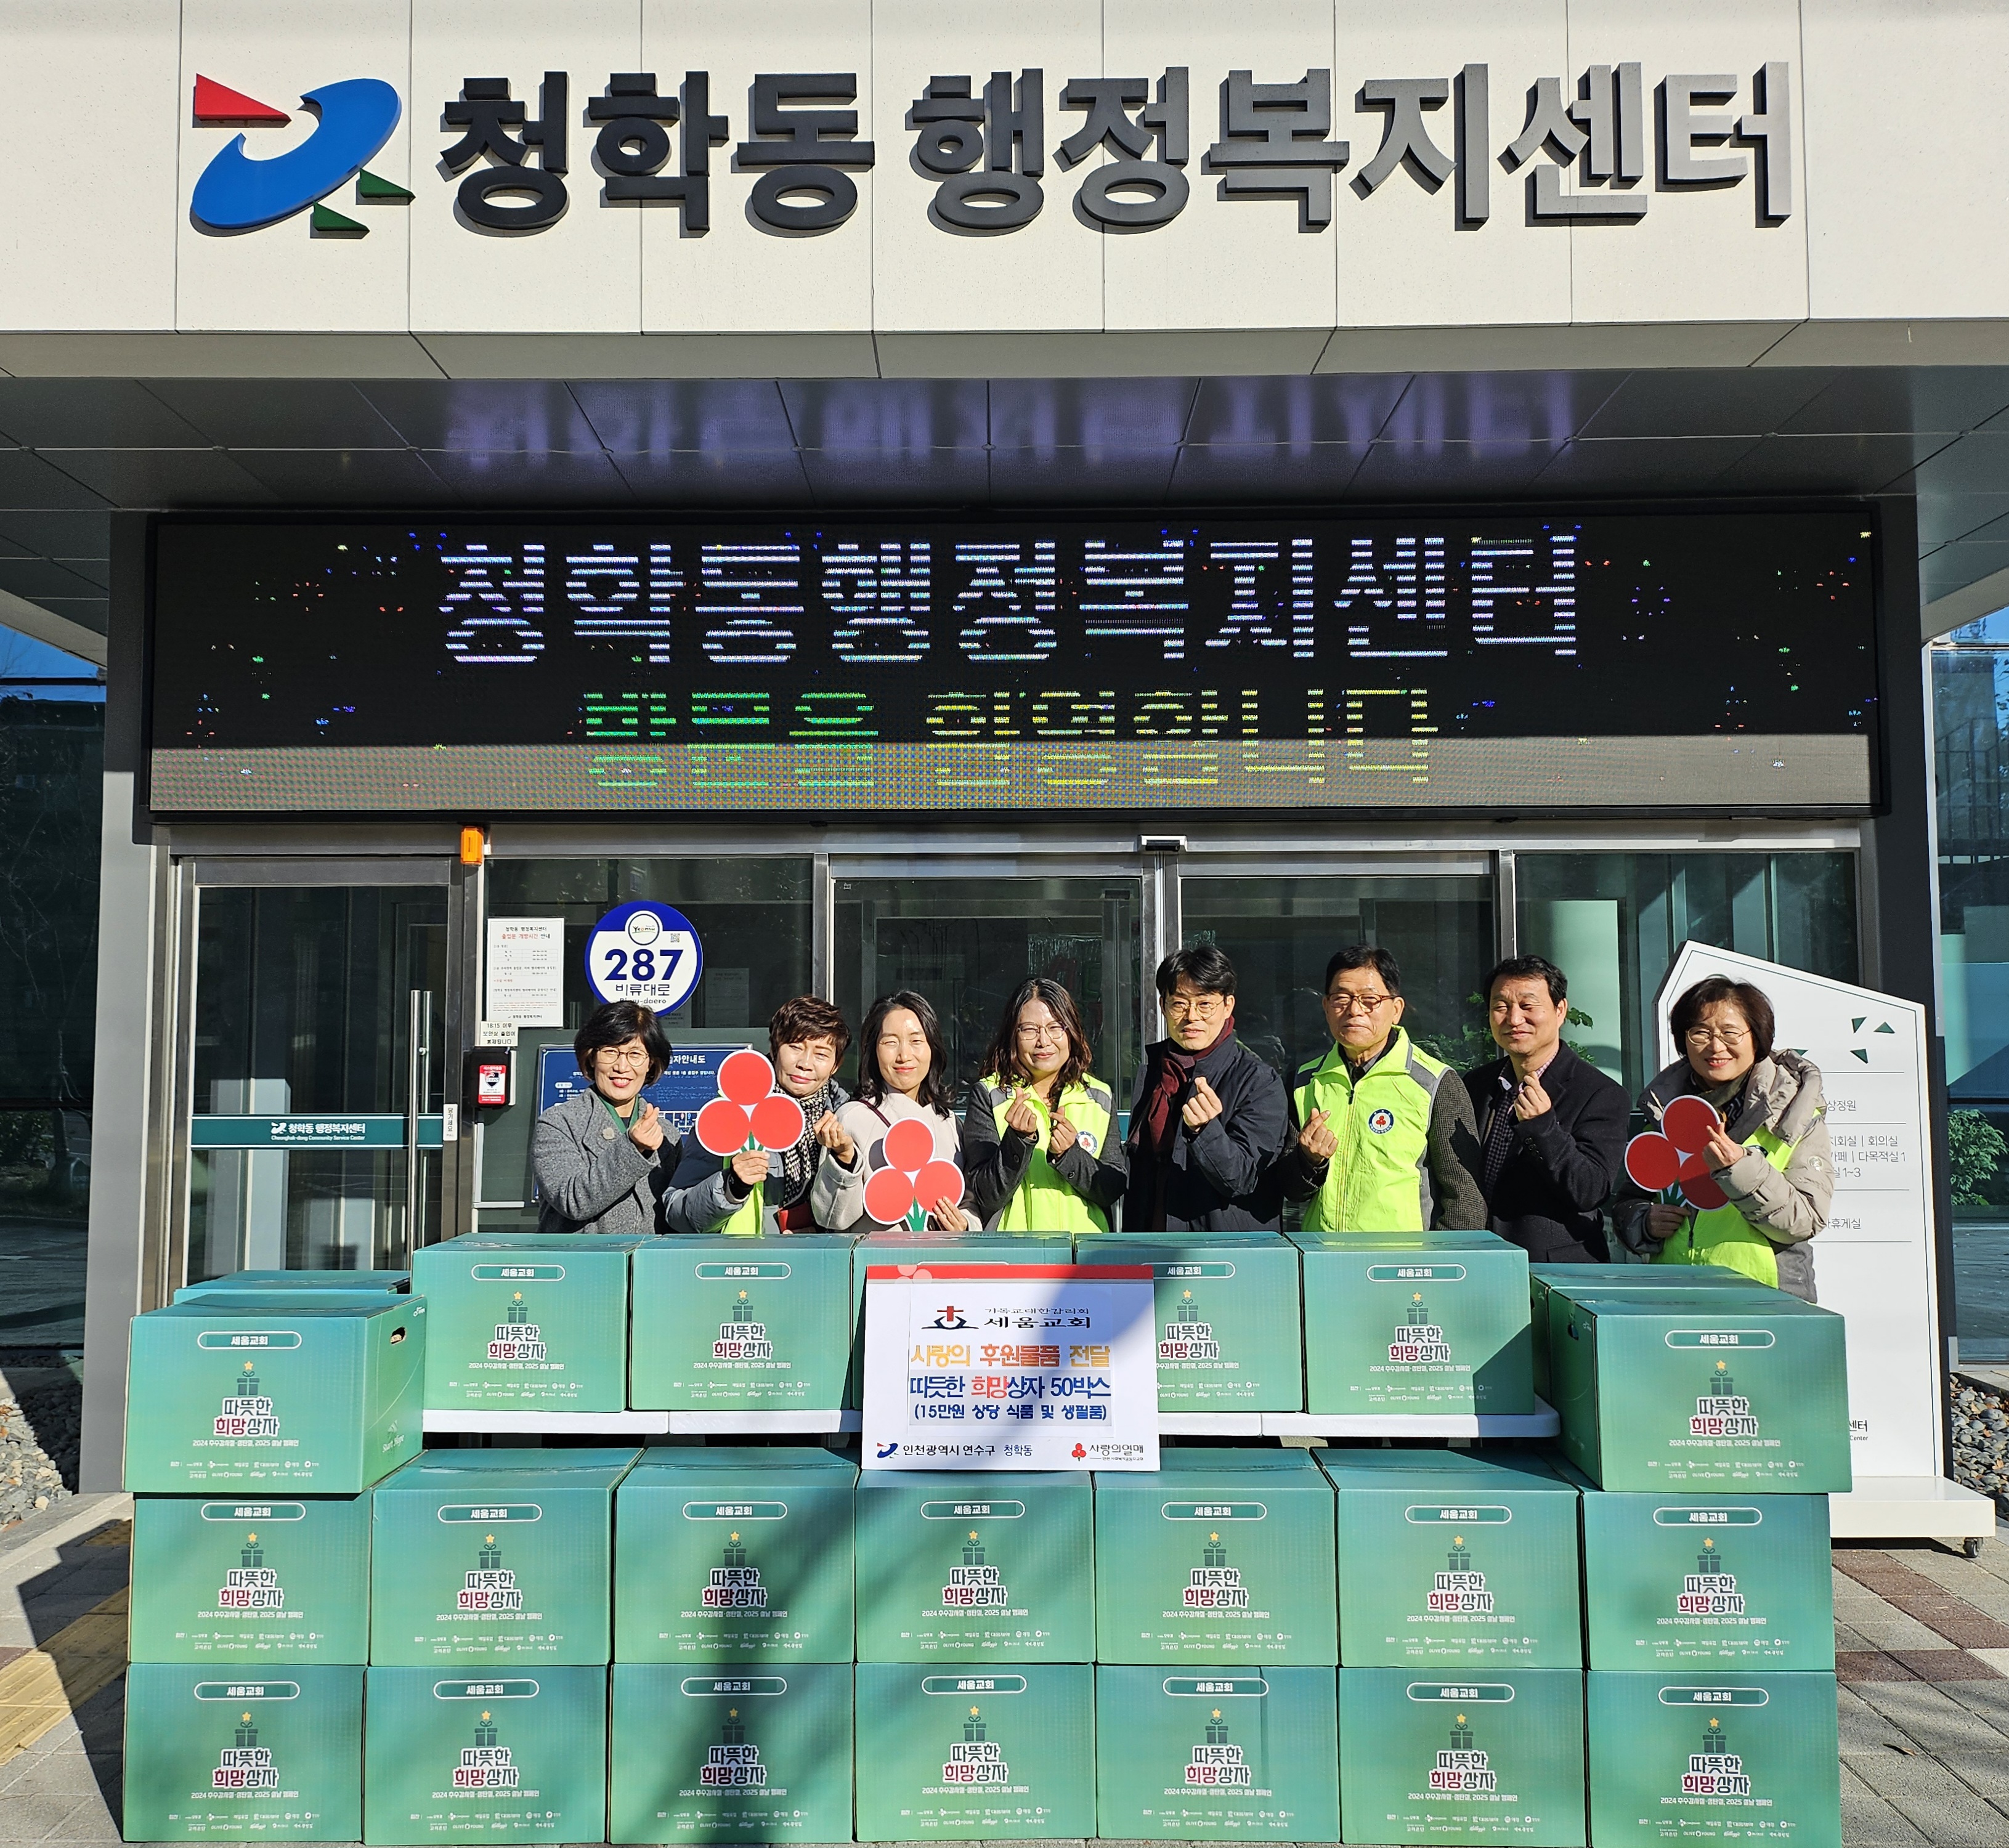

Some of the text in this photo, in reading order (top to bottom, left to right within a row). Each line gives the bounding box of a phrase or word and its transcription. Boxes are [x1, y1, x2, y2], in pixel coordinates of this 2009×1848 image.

[439, 60, 1793, 234] 청학동 행정복지센터
[604, 949, 684, 981] 287
[615, 984, 670, 996] 비류대로
[288, 1123, 366, 1133] 청학동 행정복지센터
[1868, 1135, 1898, 1147] 회의실
[501, 1268, 535, 1278] 세움교회
[725, 1266, 760, 1276] 세움교회
[1168, 1266, 1204, 1276] 세움교회
[1398, 1268, 1434, 1278] 세움교회
[984, 1316, 1090, 1329] 세움교회
[231, 1335, 269, 1346] 세움교회
[497, 1325, 538, 1342] 따뜻한
[721, 1324, 765, 1340] 따뜻한
[1166, 1324, 1211, 1341] 따뜻한
[1396, 1327, 1442, 1343] 따뜻한
[1700, 1334, 1740, 1345] 세움교회
[489, 1342, 546, 1360] 희망상자
[714, 1342, 773, 1358] 희망상자
[911, 1343, 1111, 1368] 사랑의 후원물품 전달
[1159, 1342, 1220, 1358] 희망상자
[1389, 1344, 1451, 1361] 희망상자
[971, 1376, 1045, 1399] 희망상자
[1050, 1376, 1111, 1399] 50박스
[224, 1398, 271, 1416] 따뜻한
[914, 1404, 1107, 1420] (15만원 상당 식품 및 생필품)
[1698, 1398, 1749, 1416] 따뜻한
[216, 1417, 279, 1435] 희망상자
[1690, 1417, 1759, 1435] 희망상자
[903, 1444, 1033, 1457] 인천광역시 연수구 청학동
[1089, 1444, 1144, 1456] 사랑의열매
[235, 1507, 272, 1518] 세움교회
[471, 1508, 509, 1519] 세움교회
[716, 1506, 754, 1517] 세움교회
[954, 1504, 992, 1515] 세움교회
[1195, 1506, 1233, 1517] 세움교회
[1439, 1509, 1478, 1520] 세움교회
[1688, 1512, 1728, 1522] 세움교회
[229, 1570, 275, 1588] 따뜻한
[466, 1571, 514, 1590] 따뜻한
[712, 1569, 759, 1587] 따뜻한
[951, 1568, 999, 1586] 따뜻한
[1191, 1570, 1240, 1587] 따뜻한
[1436, 1573, 1485, 1592] 따뜻한
[1686, 1576, 1735, 1594] 따뜻한
[221, 1589, 283, 1607] 희망상자
[458, 1591, 522, 1610] 희망상자
[704, 1588, 768, 1607] 희망상자
[943, 1587, 1008, 1605] 희망상자
[1184, 1589, 1249, 1607] 희망상자
[1429, 1592, 1495, 1611] 희망상자
[1678, 1595, 1745, 1613] 희망상자
[922, 1610, 938, 1618] 2024
[984, 1609, 1000, 1617] 2025
[1225, 1611, 1242, 1619] 2025
[228, 1686, 266, 1696] 세움교회
[467, 1684, 505, 1695] 세움교회
[715, 1681, 753, 1692] 세움교회
[956, 1679, 994, 1691] 세움교회
[1196, 1682, 1235, 1693] 세움교회
[1441, 1687, 1480, 1699] 세움교회
[1693, 1691, 1734, 1703] 세움교회
[222, 1749, 270, 1768] 따뜻한
[463, 1748, 510, 1767] 따뜻한
[710, 1746, 758, 1765] 따뜻한
[952, 1744, 1000, 1763] 따뜻한
[1193, 1746, 1242, 1765] 따뜻한
[1438, 1751, 1487, 1770] 따뜻한
[944, 1763, 1009, 1782] 희망상자
[1690, 1755, 1741, 1775] 따뜻한
[214, 1769, 278, 1787] 희망상자
[455, 1767, 519, 1787] 희망상자
[702, 1765, 766, 1785] 희망상자
[1186, 1765, 1251, 1785] 희망상자
[1431, 1770, 1497, 1789] 희망상자
[985, 1786, 1001, 1794] 2025
[1683, 1775, 1751, 1794] 희망상자
